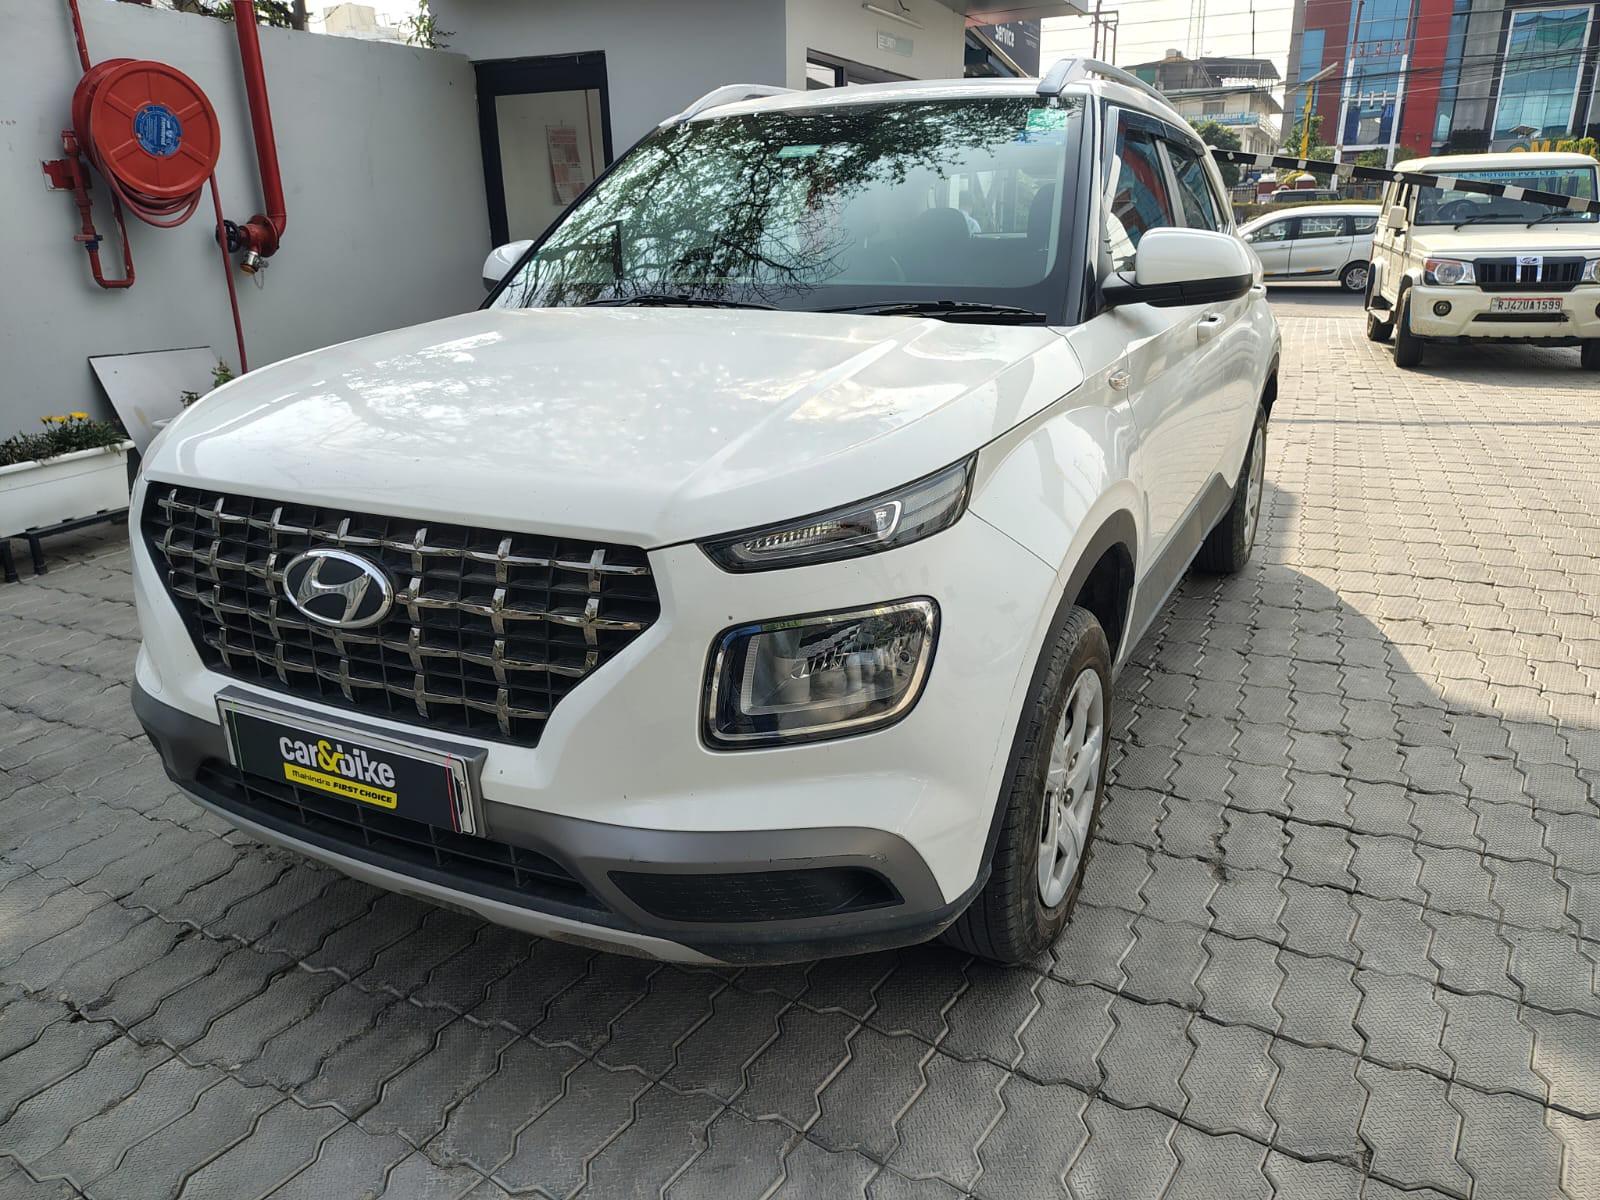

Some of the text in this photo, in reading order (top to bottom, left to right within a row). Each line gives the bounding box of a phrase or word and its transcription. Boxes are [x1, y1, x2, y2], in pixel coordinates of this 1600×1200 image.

[1497, 299, 1561, 311] RJ47UA1599
[279, 736, 396, 789] car&bike
[333, 782, 358, 794] FIRST
[359, 789, 392, 804] CHOICE
